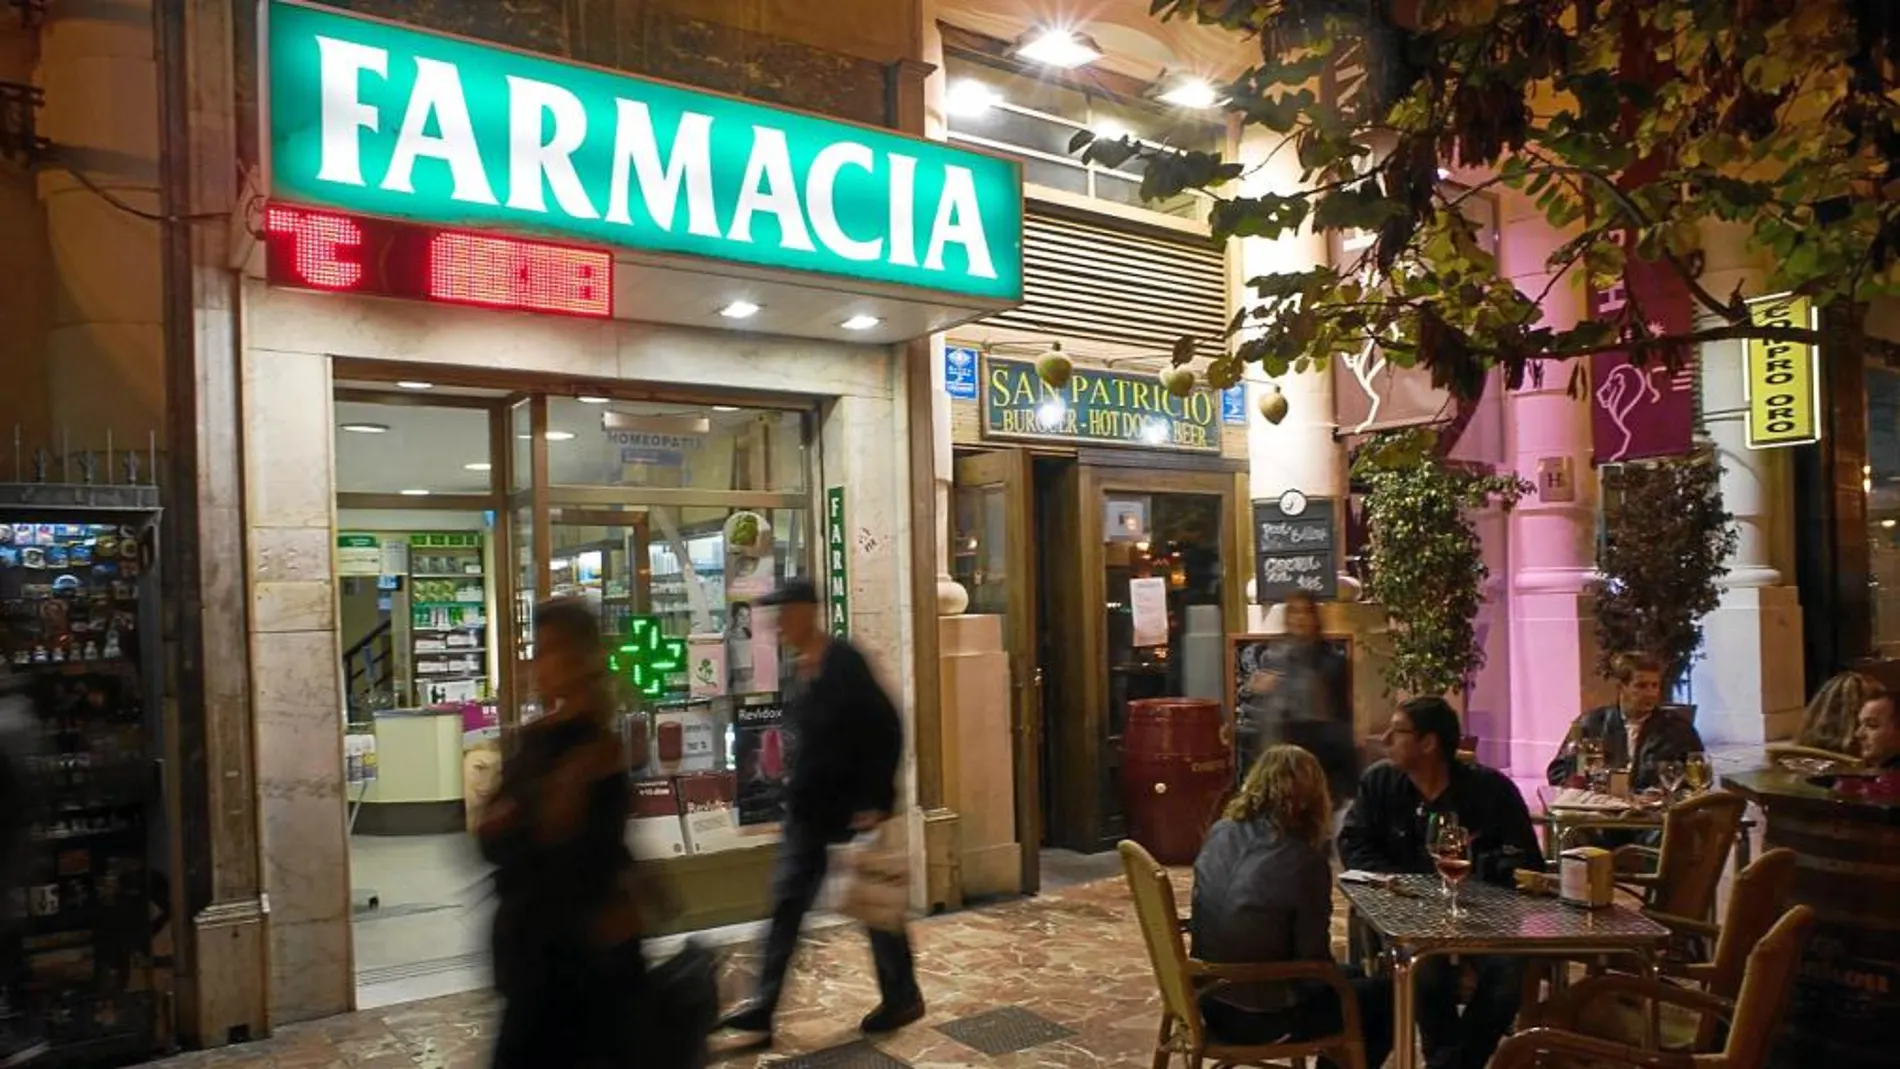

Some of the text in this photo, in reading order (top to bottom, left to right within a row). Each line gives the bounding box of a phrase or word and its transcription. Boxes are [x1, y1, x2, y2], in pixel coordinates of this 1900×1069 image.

[315, 35, 998, 280] FARMACIA
[1072, 374, 1212, 426] PATRICIO
[1766, 394, 1795, 433] ORO
[1088, 407, 1120, 438] HOT
[1172, 419, 1208, 448] BEER
